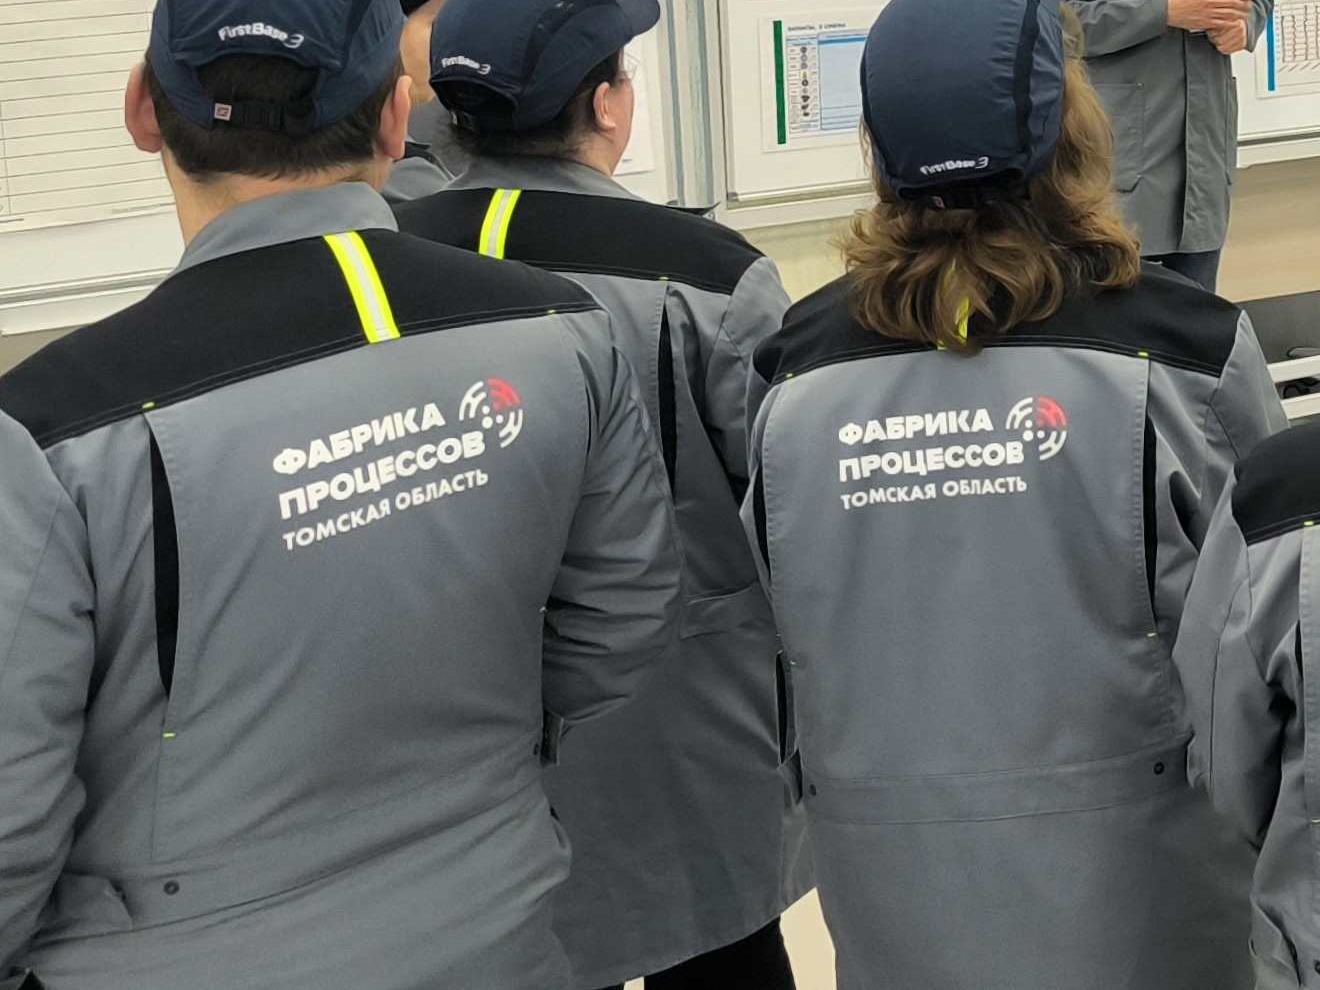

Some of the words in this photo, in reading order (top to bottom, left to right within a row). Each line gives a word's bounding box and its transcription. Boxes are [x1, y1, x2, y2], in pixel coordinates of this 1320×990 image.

[273, 402, 446, 475] ФАБРИКА
[838, 408, 994, 446] ФАБРИКА
[278, 430, 486, 520] ПРОЦЕССОВ
[838, 440, 1025, 483] ПРОЦЕССОВ
[283, 498, 391, 551] ТОМСКАЯ
[395, 468, 489, 510] ОБЛАСТЬ
[840, 483, 937, 510] ТОМСКАЯ
[942, 476, 1027, 497] ОБЛАСТЬ
